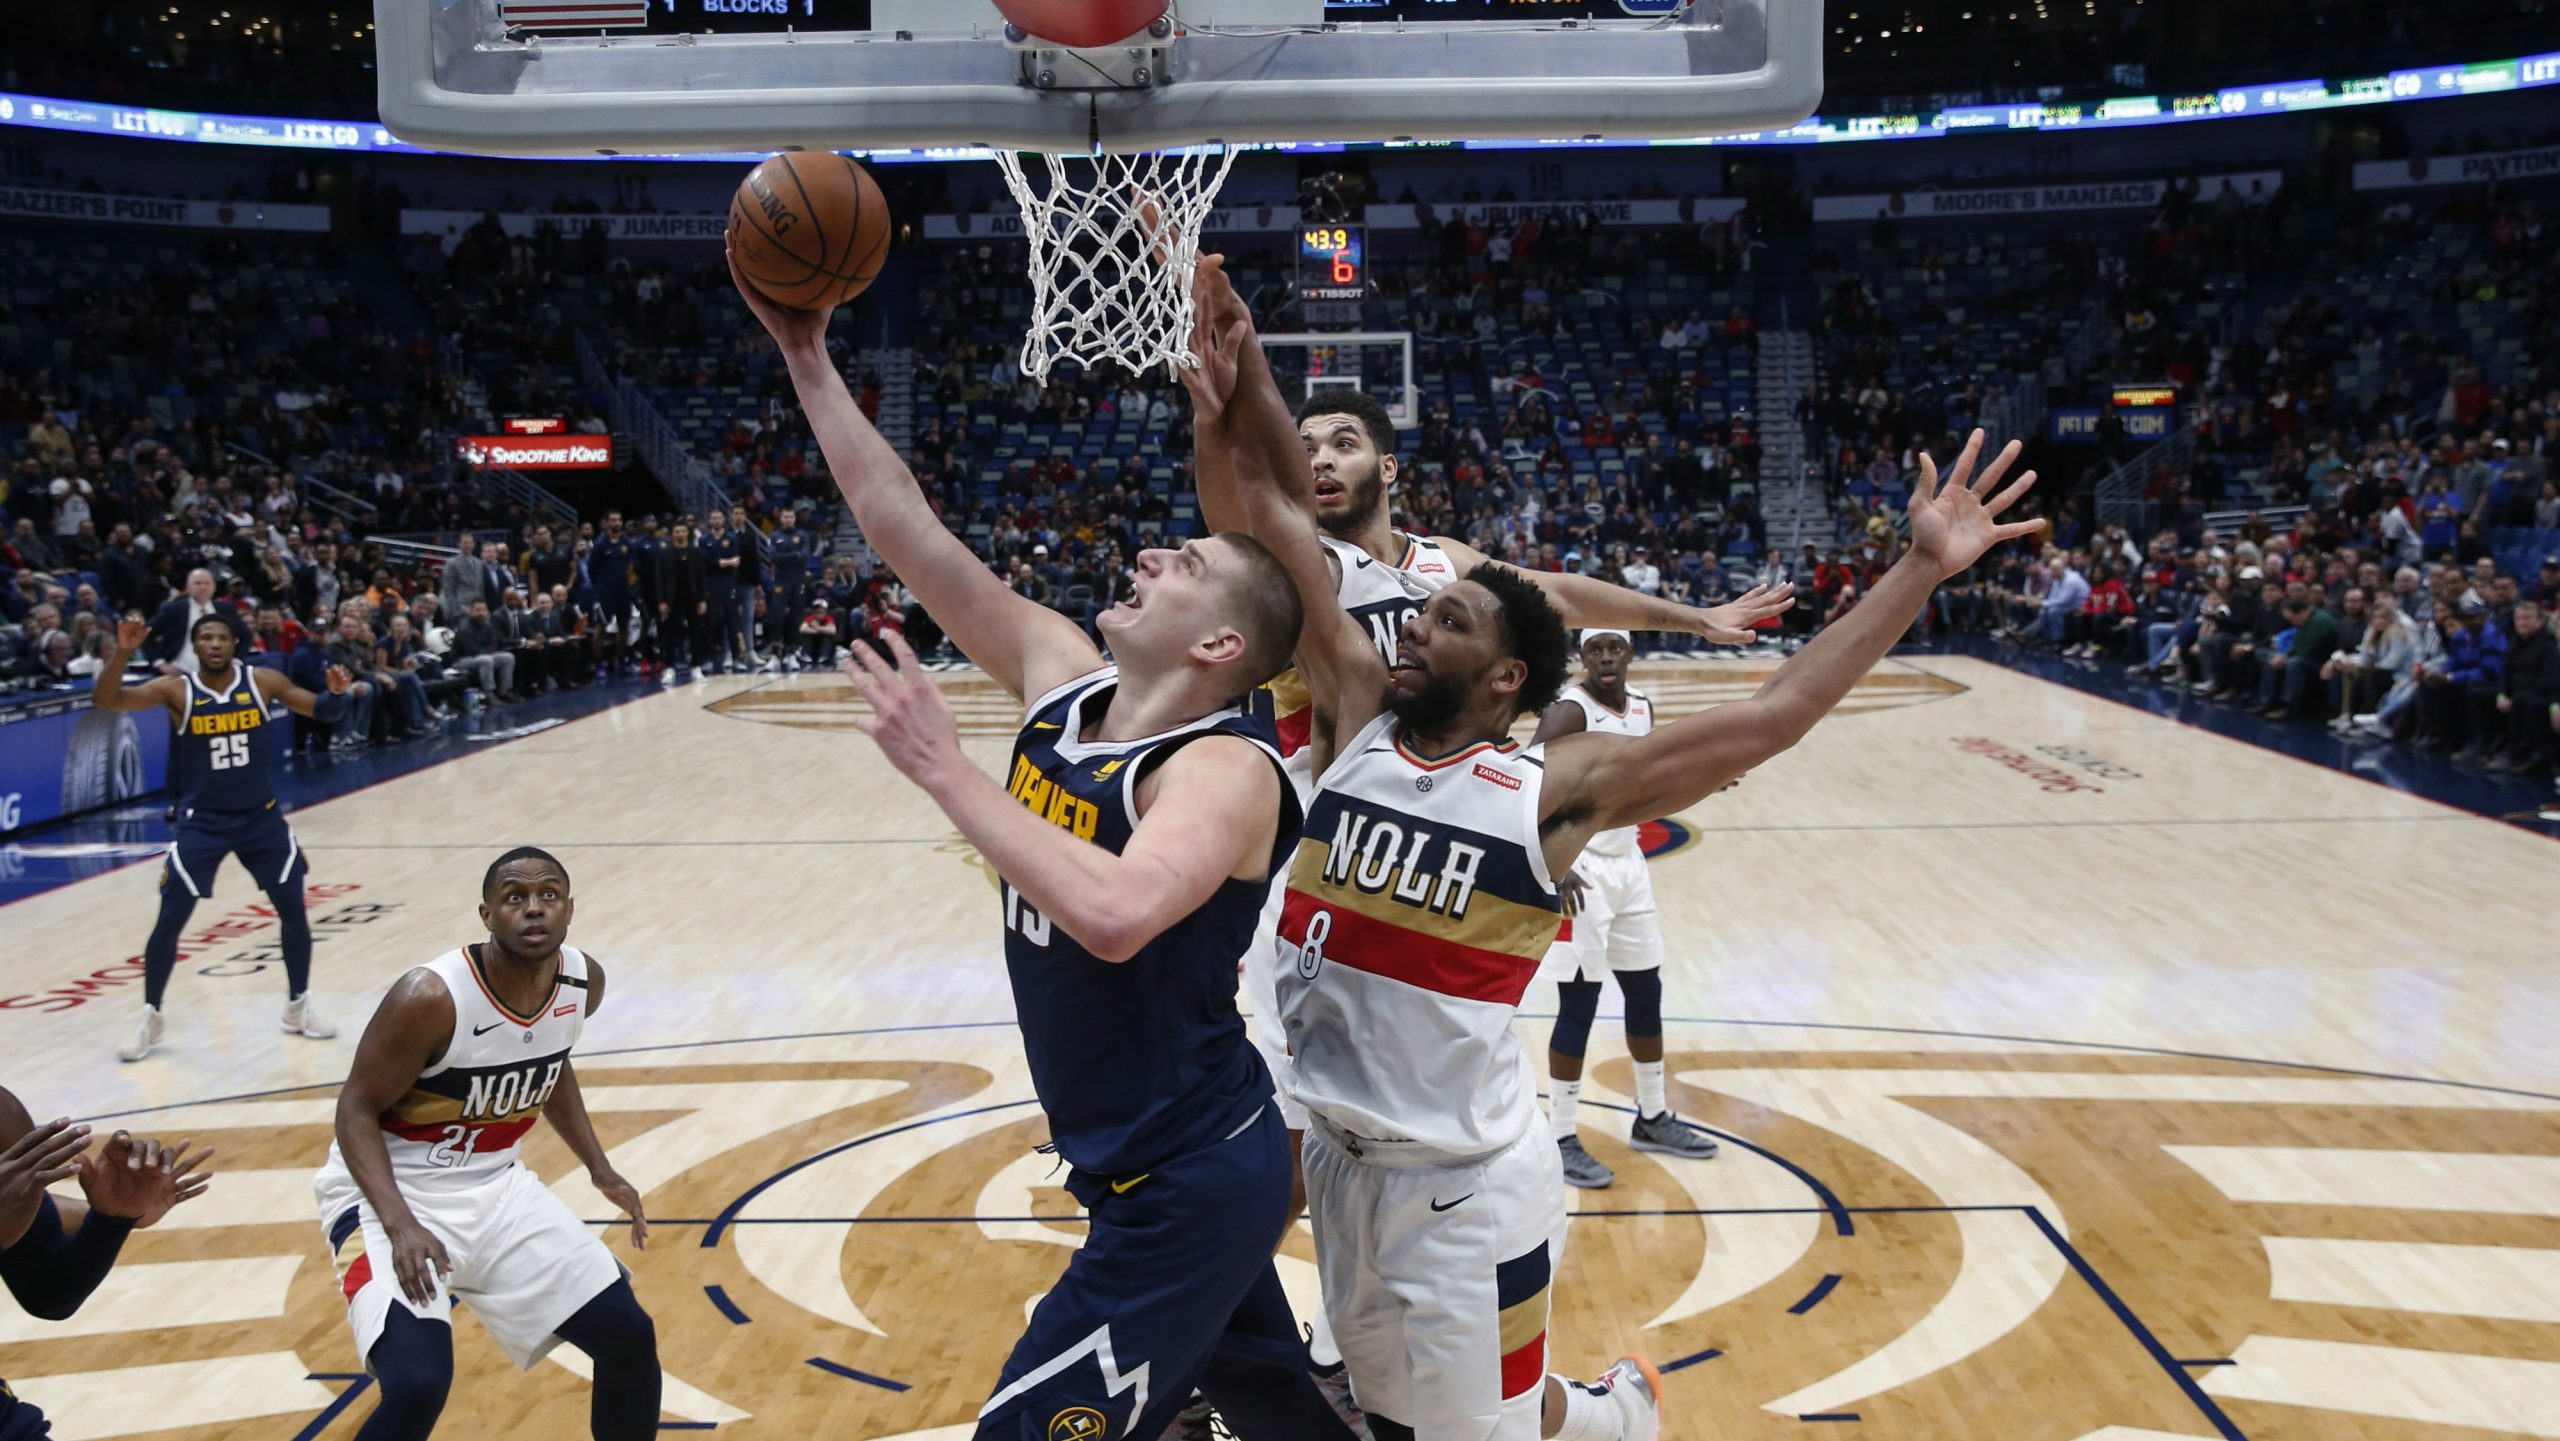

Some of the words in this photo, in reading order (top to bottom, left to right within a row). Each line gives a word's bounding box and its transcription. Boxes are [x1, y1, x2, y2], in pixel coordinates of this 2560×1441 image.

[704, 0, 788, 14] BLOCKS
[115, 199, 187, 221] POINT
[622, 217, 728, 236] JUMPERS
[1304, 228, 1348, 250] 43.9
[1332, 249, 1354, 282] 6
[1318, 288, 1363, 298] TISSOT
[490, 446, 568, 464] SMOOTHIE
[568, 444, 608, 463] KING
[191, 708, 261, 735] DENVER
[209, 733, 250, 771] 25
[1321, 809, 1487, 920] NOLA
[1297, 908, 1333, 981] 8
[461, 1058, 564, 1120] NOLA
[425, 1123, 485, 1168] 21
